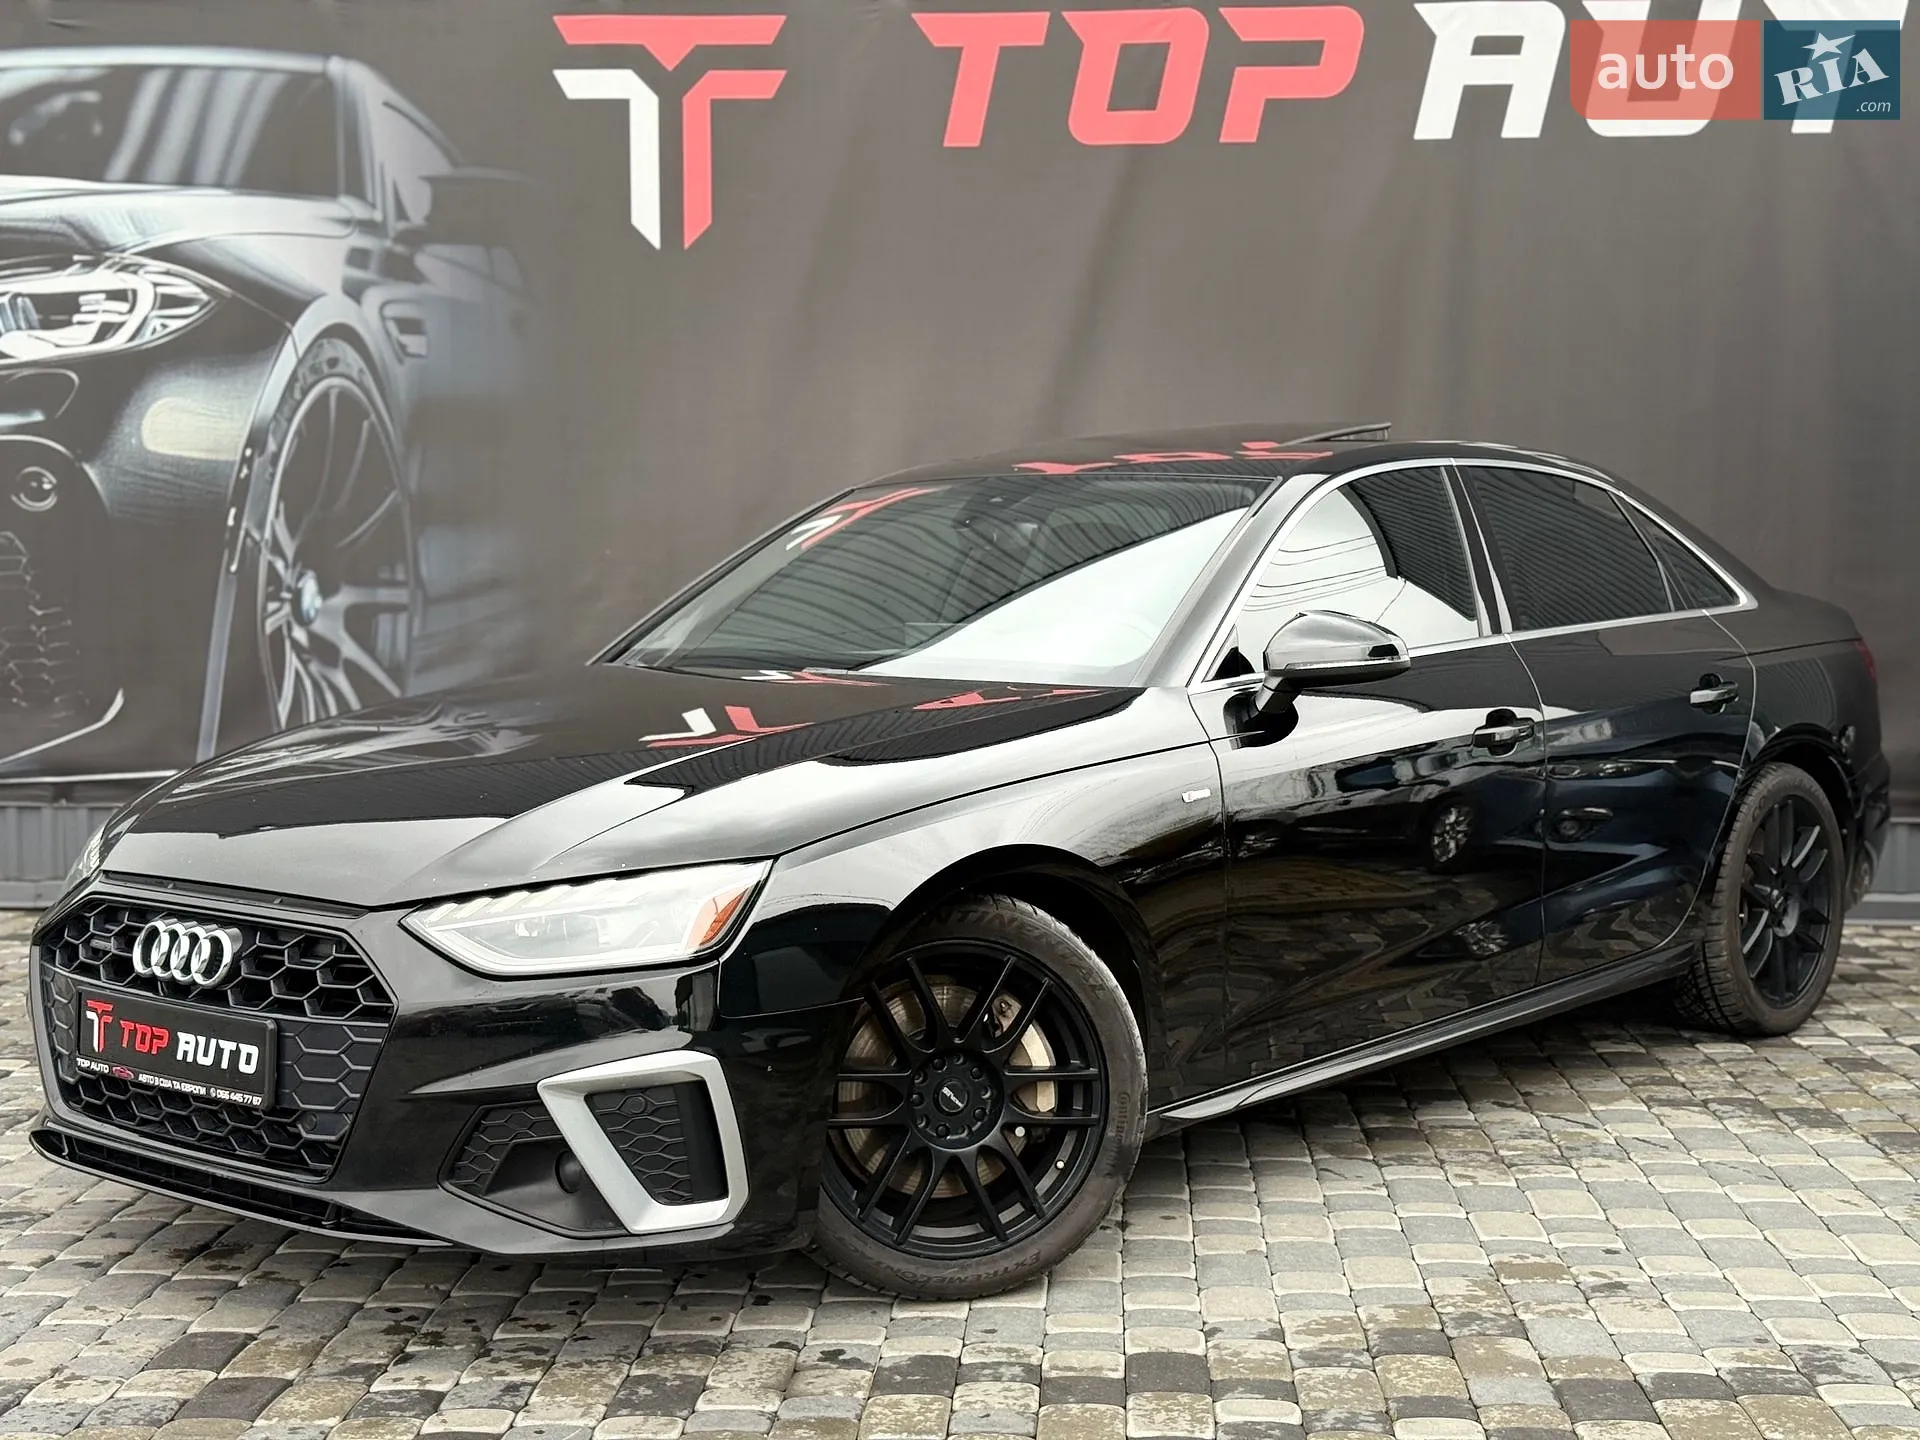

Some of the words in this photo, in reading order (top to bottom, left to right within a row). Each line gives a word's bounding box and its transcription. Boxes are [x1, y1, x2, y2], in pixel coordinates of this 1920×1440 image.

[911, 5, 1366, 149] TOP
[76, 1057, 90, 1067] TOP
[91, 1062, 109, 1073] AUTO
[120, 1020, 170, 1055] TOP
[176, 1031, 260, 1075] AUTO
